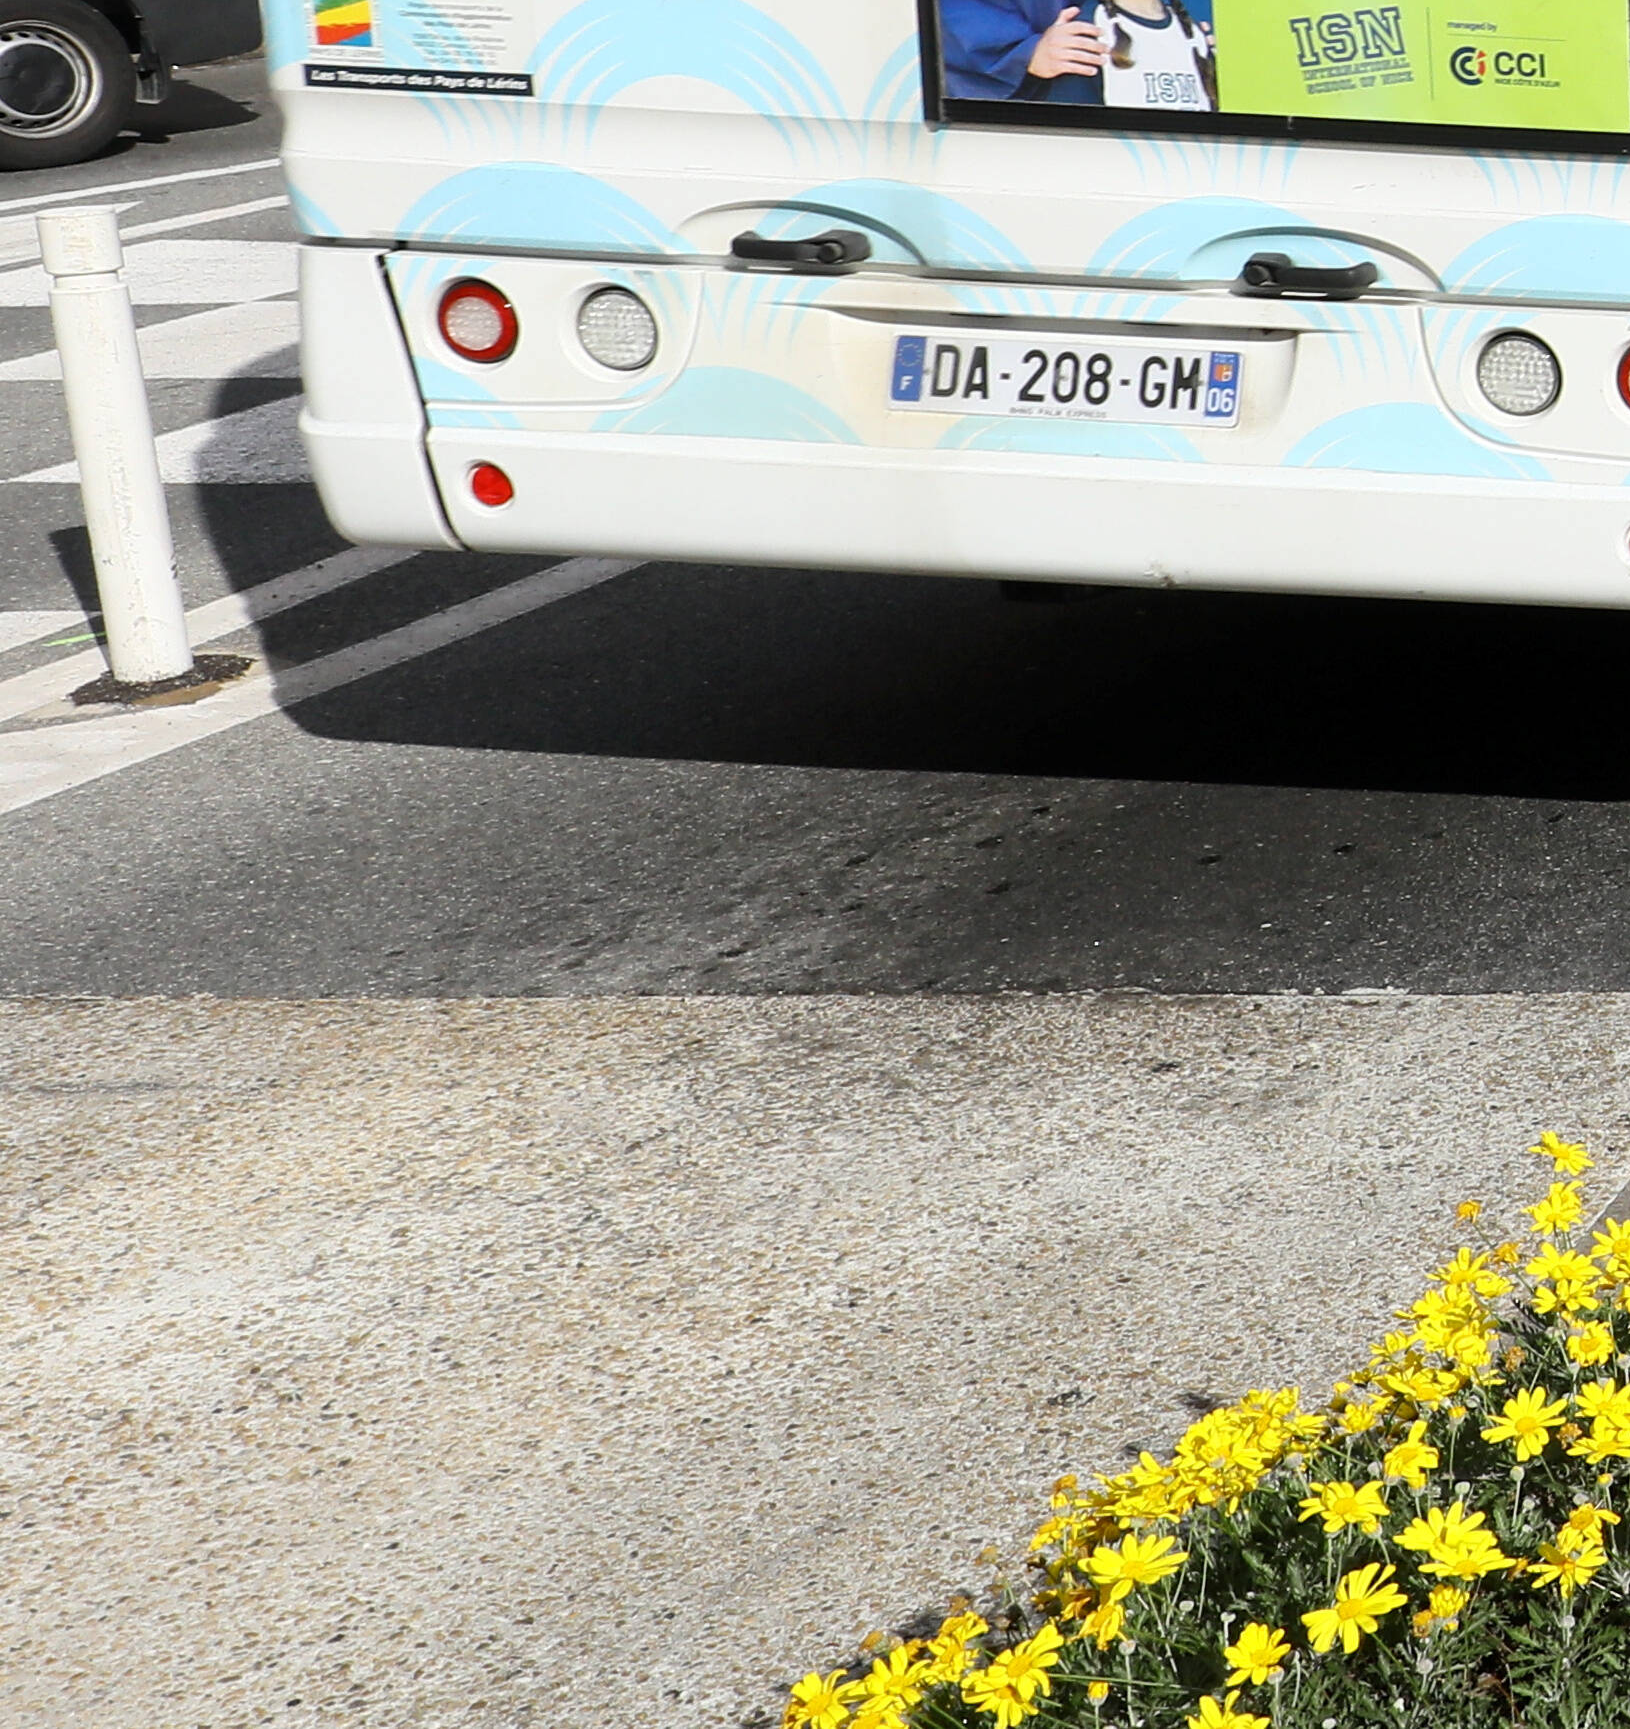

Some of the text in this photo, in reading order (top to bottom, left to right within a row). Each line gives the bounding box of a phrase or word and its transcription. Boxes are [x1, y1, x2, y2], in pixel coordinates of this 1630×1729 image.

[1288, 5, 1407, 68] ISN
[1447, 21, 1498, 33] managed by
[1494, 51, 1546, 78] CCI
[311, 69, 337, 81] Les
[338, 71, 406, 87] Transports
[407, 74, 432, 86] des
[433, 75, 466, 90] Pays
[467, 76, 486, 88] de
[1143, 72, 1200, 104] ISN
[900, 376, 912, 391] F
[930, 344, 1202, 411] DA-208-GM
[1207, 387, 1234, 413] 06
